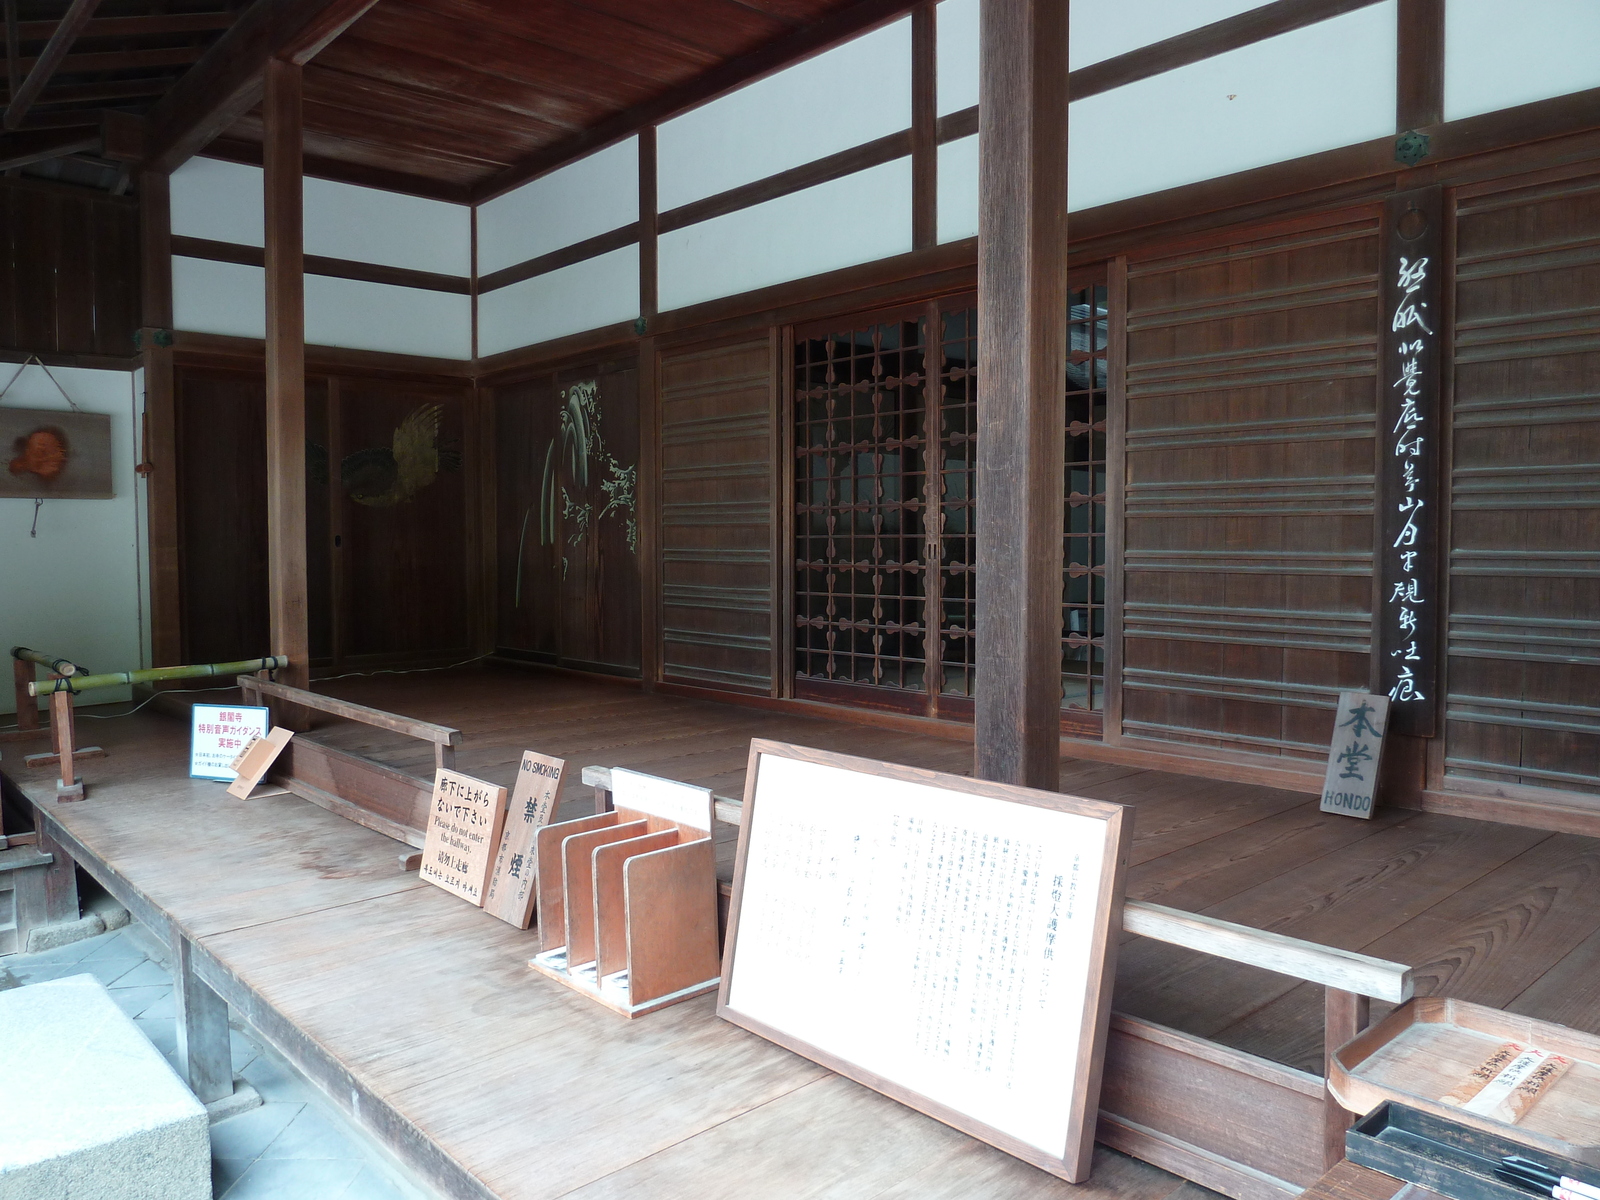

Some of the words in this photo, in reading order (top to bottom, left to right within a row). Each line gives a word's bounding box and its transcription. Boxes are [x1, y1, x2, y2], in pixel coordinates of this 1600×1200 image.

[219, 711, 242, 723] 銀閣寺
[198, 723, 262, 737] 特別音声ガイダンス
[1337, 699, 1383, 782] 本堂
[218, 738, 242, 749] 実施中
[521, 759, 531, 772] NO
[532, 762, 560, 780] SMOKING
[439, 776, 490, 808] 廊下に上がら
[1323, 789, 1370, 812] HONDO
[437, 797, 488, 827] ないで下さい
[434, 815, 451, 833] Please
[450, 822, 459, 835] do
[458, 825, 469, 838] not
[468, 829, 484, 844] enter
[440, 832, 450, 846] the
[507, 796, 538, 880] 禁煙
